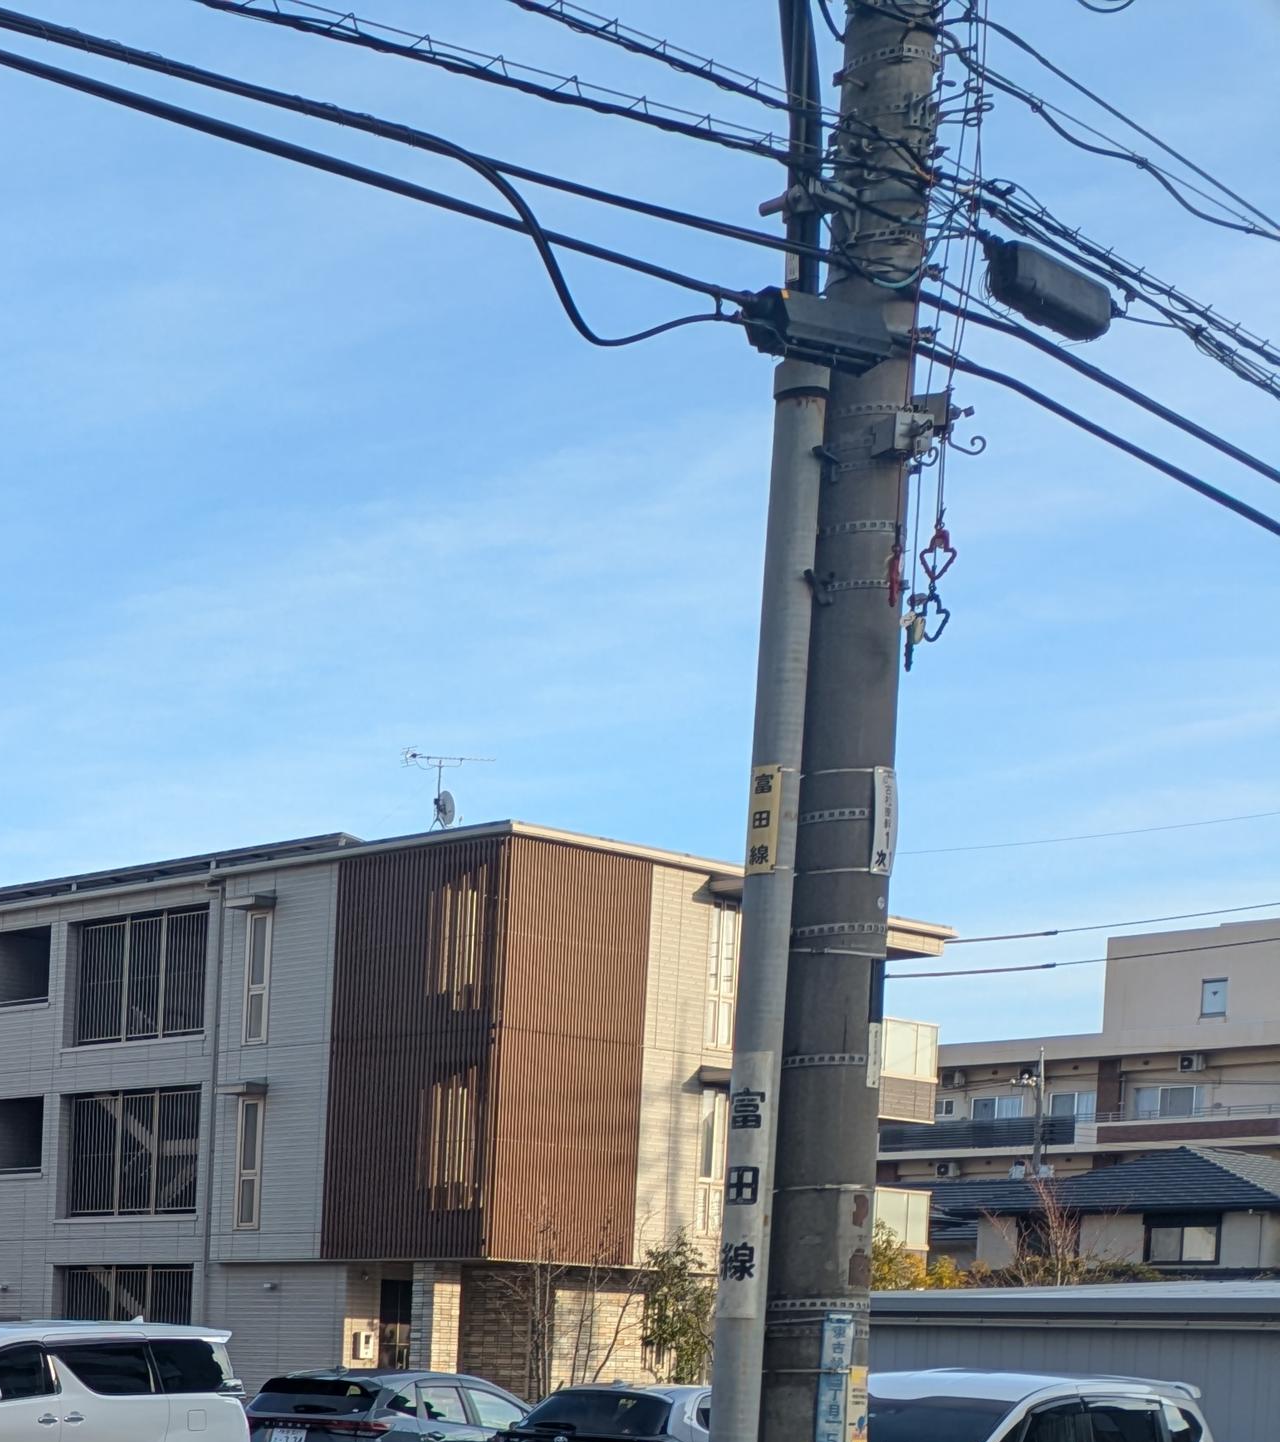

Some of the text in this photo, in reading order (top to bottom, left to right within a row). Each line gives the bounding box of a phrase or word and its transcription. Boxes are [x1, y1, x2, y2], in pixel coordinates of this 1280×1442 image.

[749, 773, 774, 866] 富田線
[720, 1087, 766, 1281] 富田線
